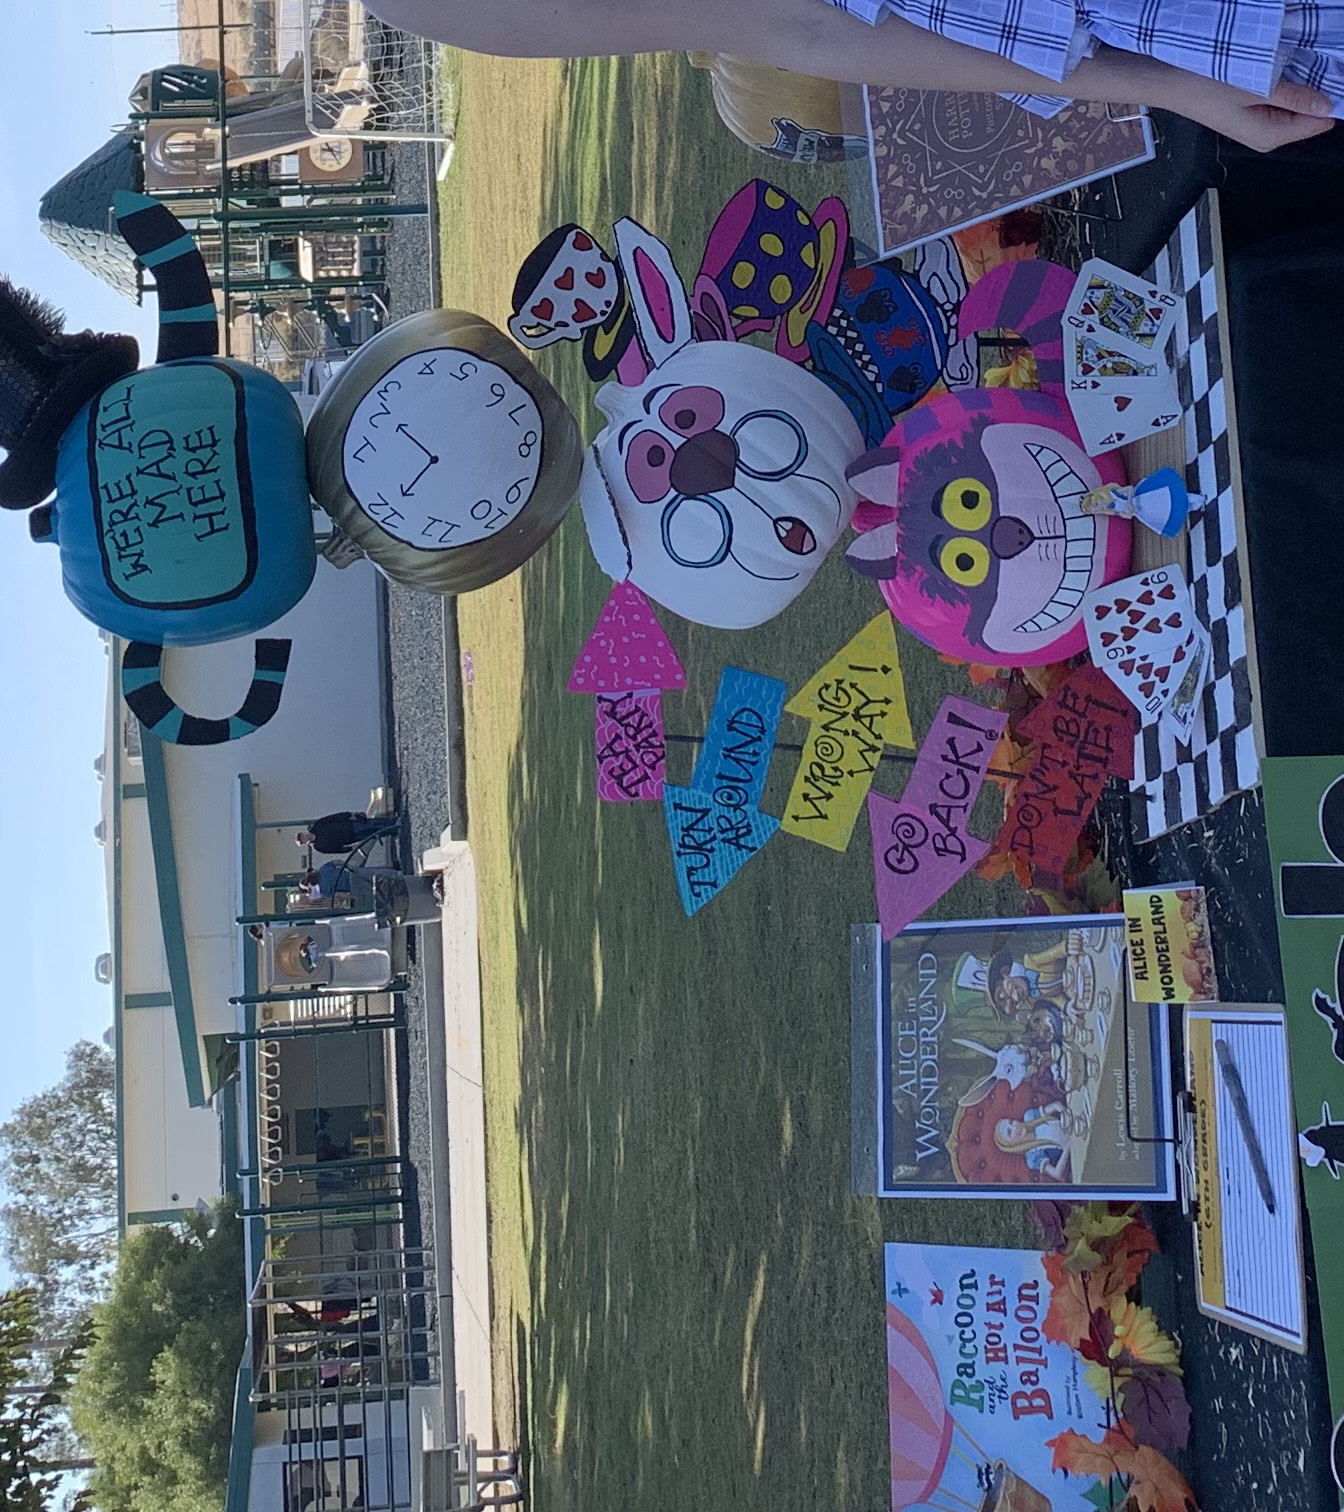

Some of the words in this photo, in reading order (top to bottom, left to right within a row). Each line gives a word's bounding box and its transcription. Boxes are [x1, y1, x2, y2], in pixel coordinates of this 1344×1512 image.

[944, 92, 960, 141] HARR
[984, 92, 995, 133] PHILOSO
[1160, 294, 1176, 307] Q
[1067, 316, 1086, 328] Q
[417, 358, 437, 376] 4
[449, 361, 478, 381] 5
[1071, 380, 1087, 391] K
[377, 380, 401, 401] 3
[485, 382, 506, 407] 6
[98, 384, 135, 453] ALL
[369, 402, 391, 428] 2
[508, 403, 527, 426] 7
[1160, 414, 1178, 426] A
[352, 435, 376, 463] 1
[518, 430, 537, 458] 8
[1099, 433, 1116, 445] A
[136, 429, 185, 529] MAD
[183, 425, 230, 542] HERE
[505, 476, 530, 504] 9
[100, 473, 153, 581] WE'RE
[368, 492, 405, 529] 12
[421, 516, 461, 543] 11
[470, 499, 508, 529] 10
[1106, 647, 1126, 660] 9
[1144, 696, 1163, 714] 10
[596, 691, 666, 771] PARTY
[791, 678, 851, 822] WRONG
[596, 732, 651, 798] TEA
[1010, 743, 1069, 857] DON'T
[1052, 684, 1088, 748] BE
[1054, 694, 1128, 817] LATE!
[712, 707, 766, 853] AROUND
[928, 711, 1000, 864] BACK!
[672, 802, 718, 898] TURN
[883, 813, 928, 874] GO
[1127, 917, 1143, 933] IN
[1130, 937, 1149, 981] ALICE
[1149, 894, 1175, 1000] WONDERLAND
[905, 997, 916, 1012] in
[898, 1019, 918, 1098] ALICE
[914, 952, 947, 1161] WONDERLAND
[1113, 1069, 1124, 1111] Carroll
[1115, 1113, 1126, 1147] Lewis
[986, 1274, 1007, 1317] Air
[949, 1268, 985, 1414] Raccoon
[984, 1321, 1009, 1365] Hot
[1010, 1280, 1053, 1421] Balloon
[983, 1376, 996, 1415] and
[995, 1370, 1009, 1404] the
